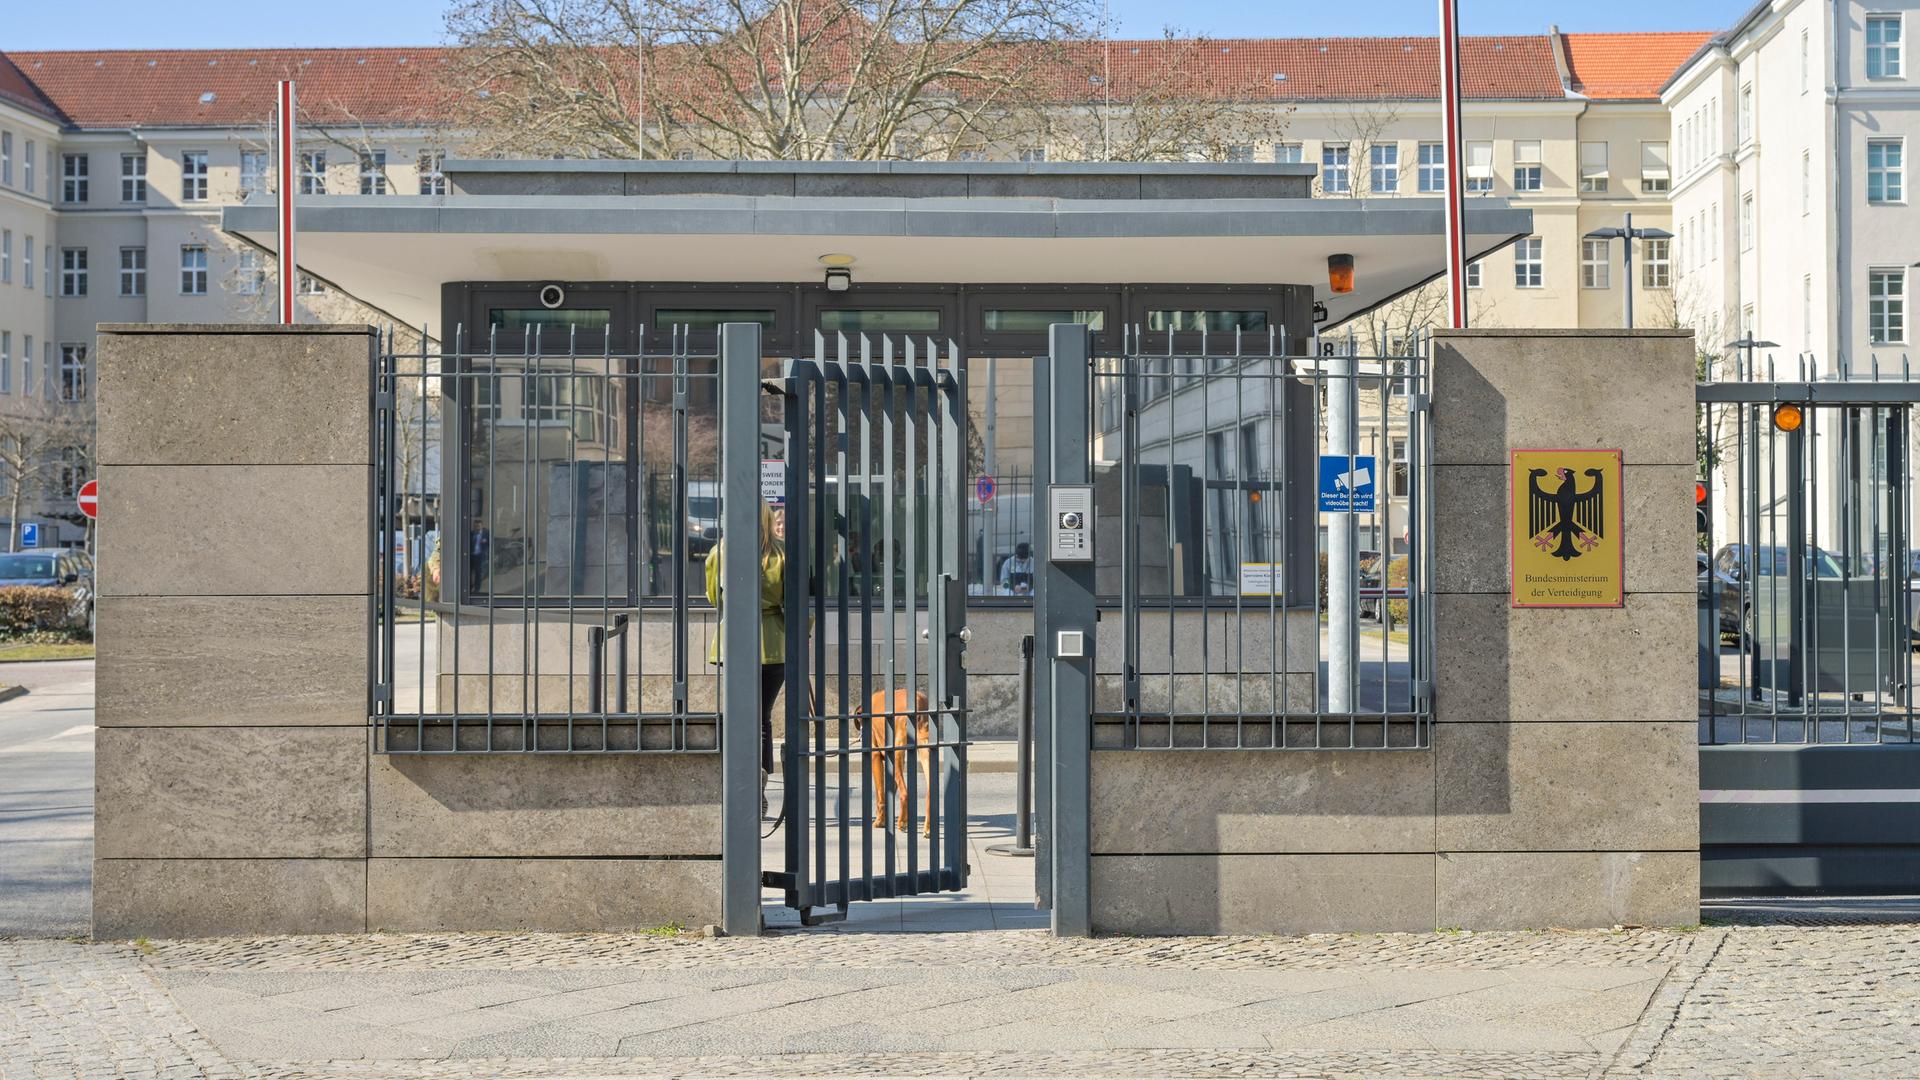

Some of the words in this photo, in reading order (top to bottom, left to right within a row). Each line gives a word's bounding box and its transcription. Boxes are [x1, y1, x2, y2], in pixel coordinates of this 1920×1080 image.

[25, 526, 32, 535] P
[1525, 573, 1609, 583] Bundesministerium
[1531, 588, 1545, 597] der
[1547, 588, 1603, 598] Verteidigung
